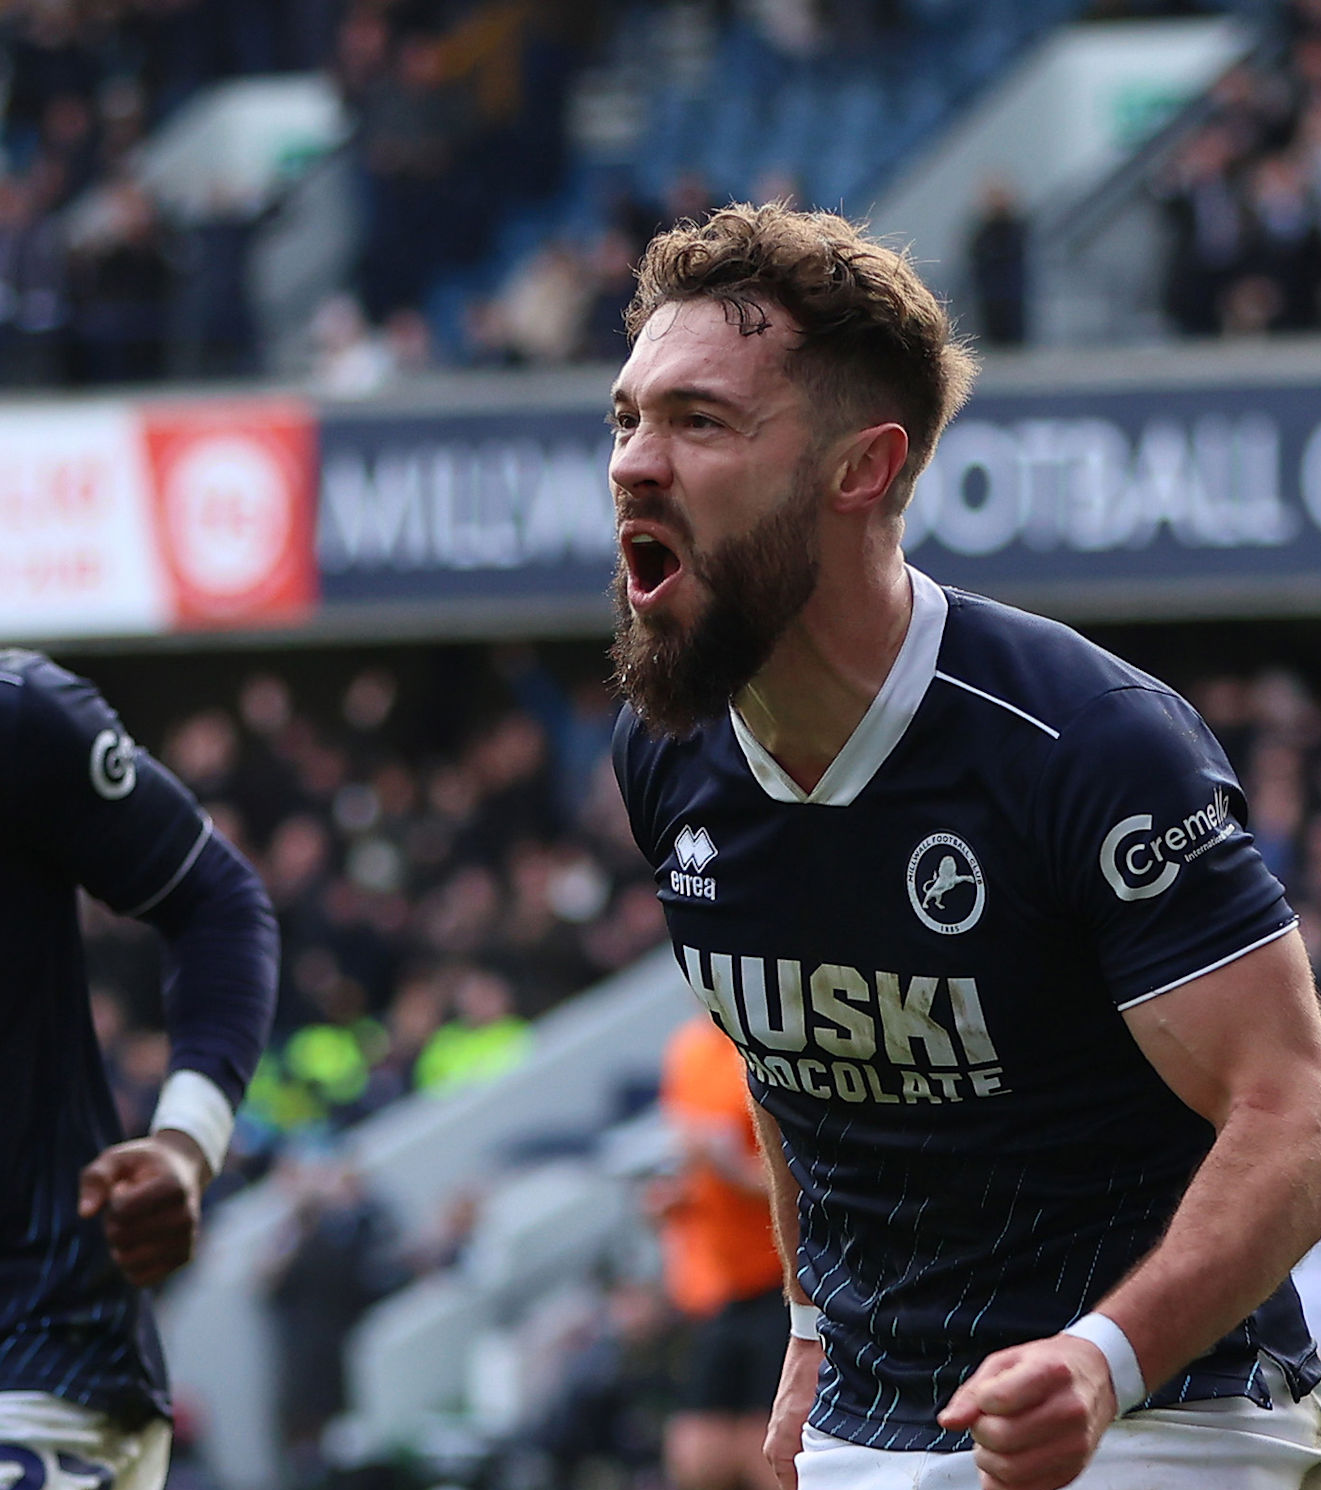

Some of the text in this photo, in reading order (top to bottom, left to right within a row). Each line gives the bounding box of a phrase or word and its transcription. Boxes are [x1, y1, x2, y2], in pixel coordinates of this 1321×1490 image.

[323, 438, 615, 568] MILLW
[671, 870, 716, 901] errea
[931, 835, 971, 858] FOOTBALL
[969, 858, 984, 886] CLUB
[682, 945, 999, 1067] HUSKI
